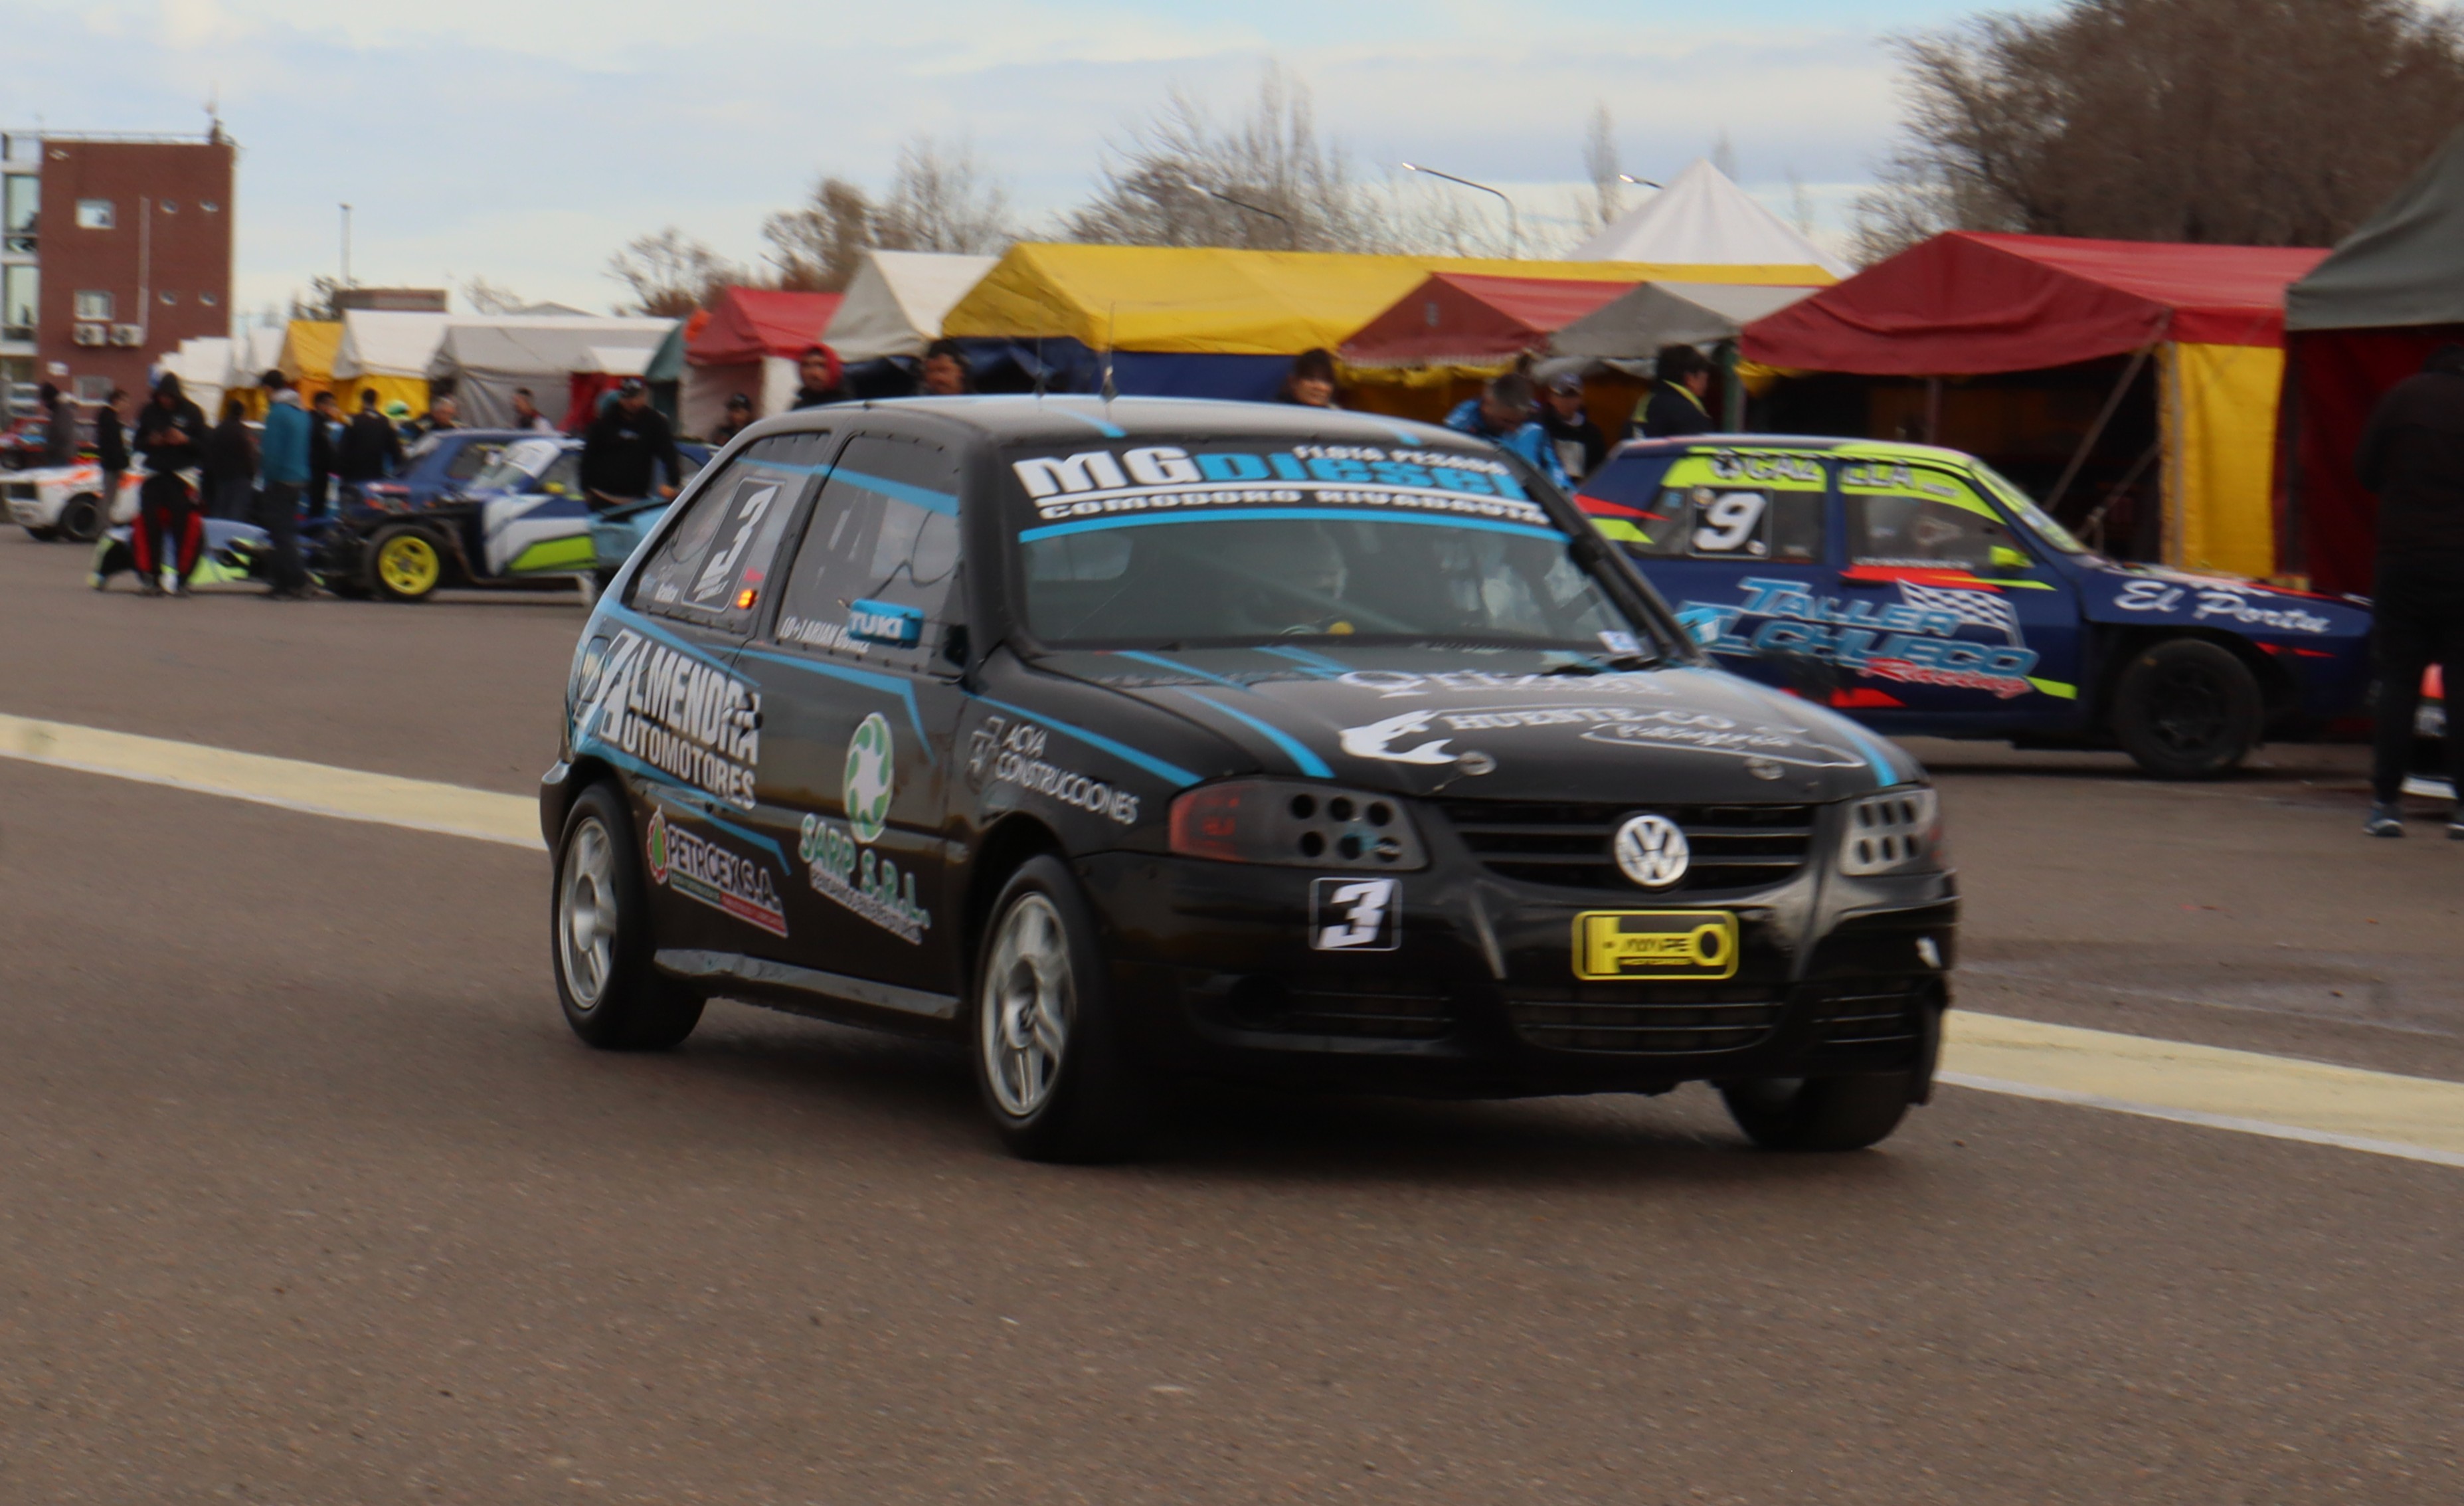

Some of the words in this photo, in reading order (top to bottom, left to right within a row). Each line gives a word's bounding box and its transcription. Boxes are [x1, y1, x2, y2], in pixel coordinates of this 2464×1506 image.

[1039, 490, 1302, 520] COMODORO
[1692, 492, 1767, 551] 9
[693, 486, 778, 594] 3
[2113, 579, 2186, 612] El
[849, 611, 905, 638] TUKI
[1316, 879, 1394, 949] 3
